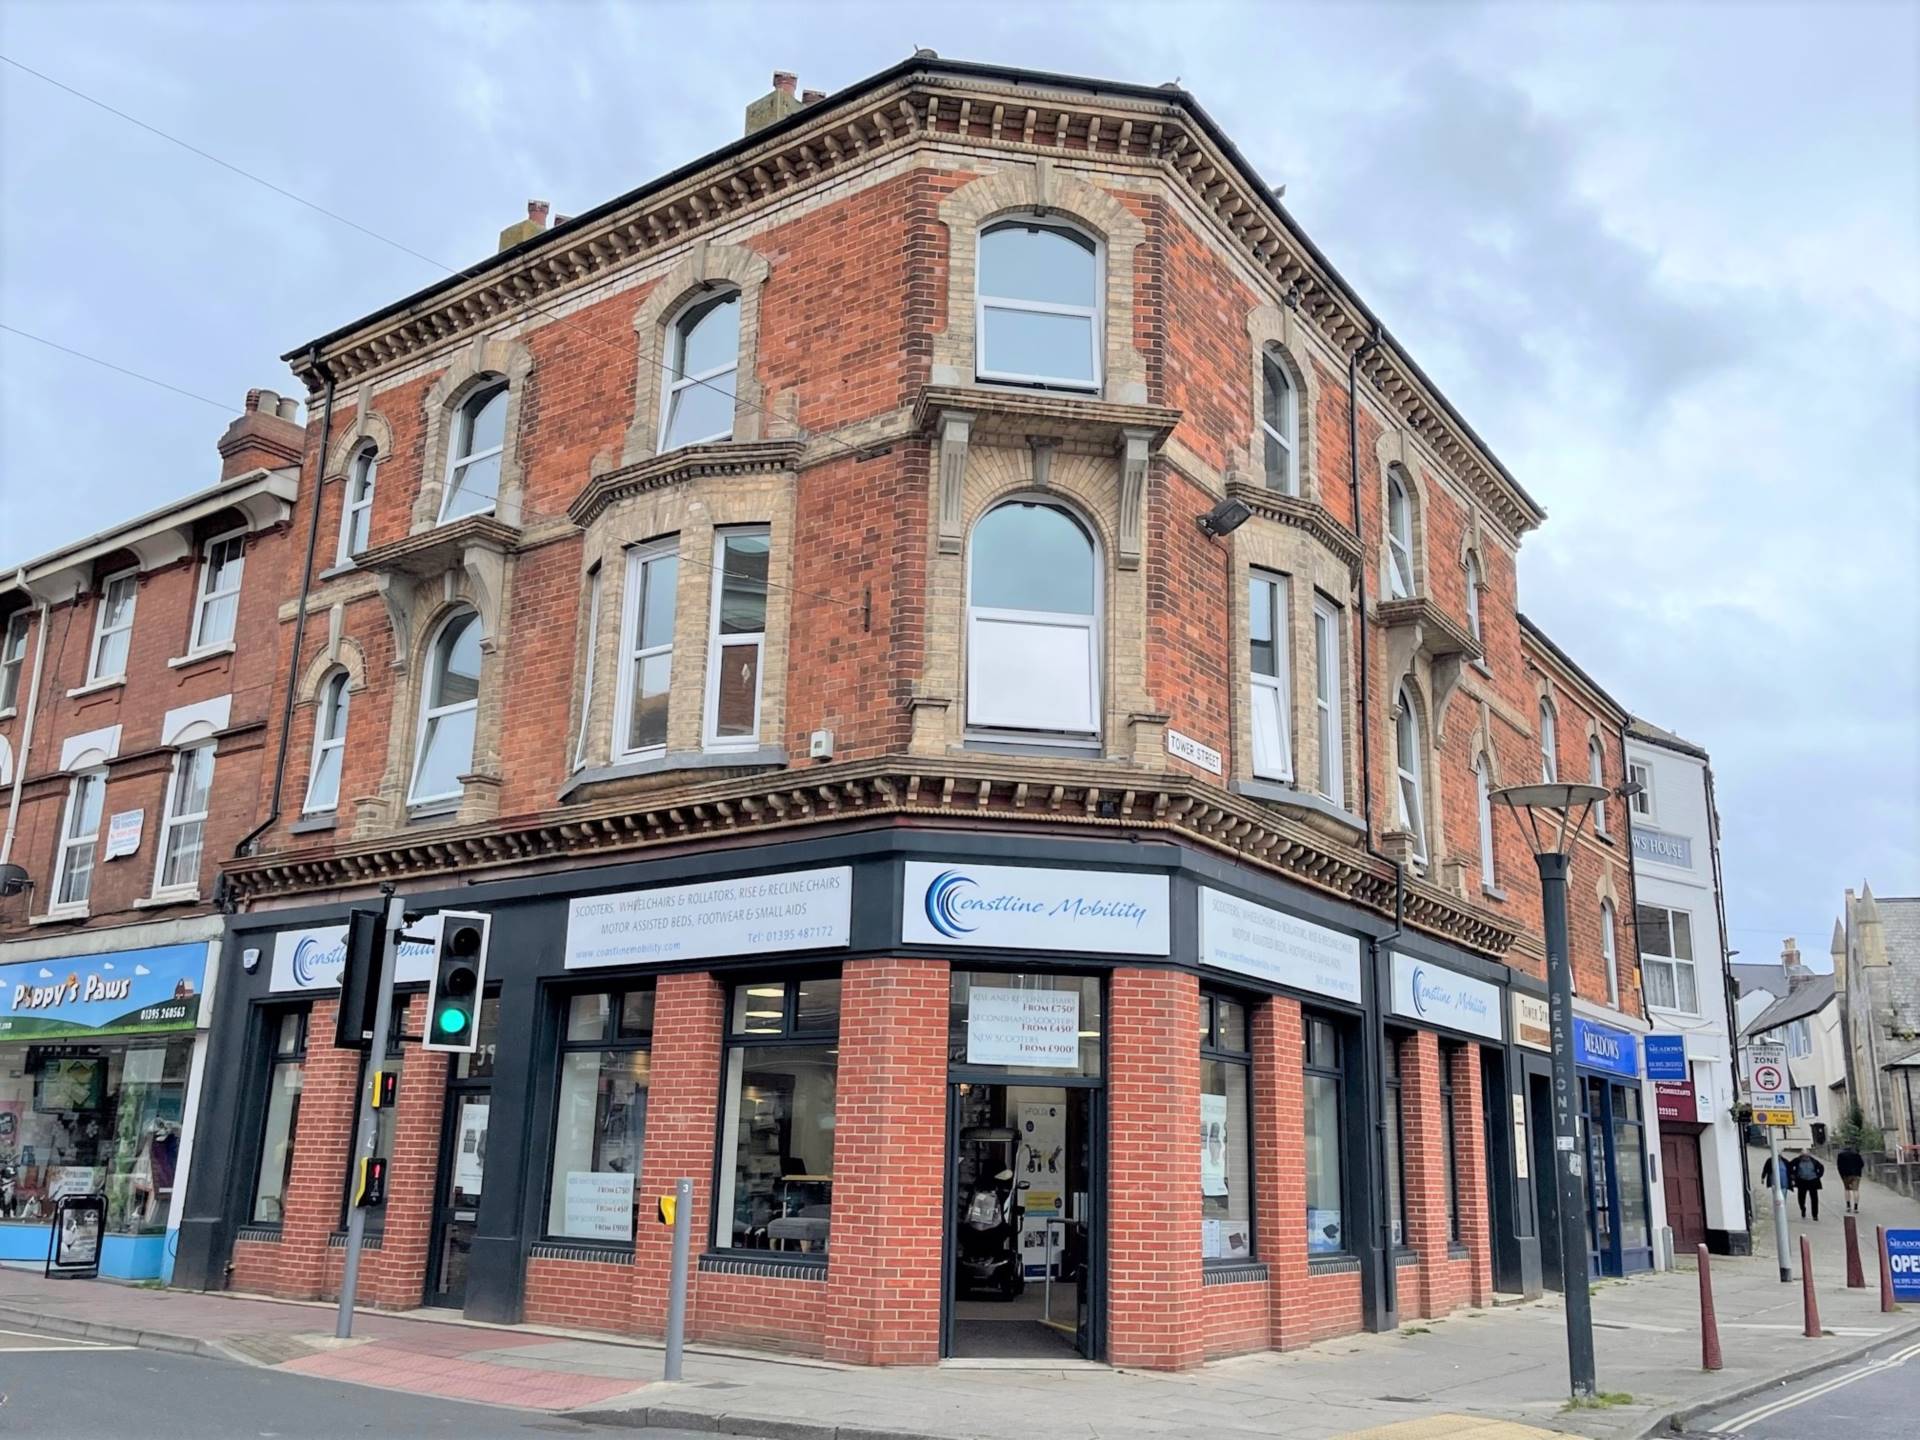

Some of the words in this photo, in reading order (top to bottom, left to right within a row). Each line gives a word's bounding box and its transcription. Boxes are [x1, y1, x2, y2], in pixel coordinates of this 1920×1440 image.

[1171, 735, 1194, 756] TOWER
[1196, 748, 1219, 769] STREET
[1650, 839, 1683, 859] HOUSE
[620, 894, 675, 913] WHEELCHAIRS
[678, 896, 685, 906] &
[740, 887, 757, 898] RISE
[760, 885, 767, 897] &
[768, 881, 804, 896] RECLINE
[806, 876, 840, 891] CHAIRS
[601, 923, 629, 935] MOTOR
[633, 917, 669, 932] ASSISTED
[671, 915, 695, 927] BEDS,
[698, 910, 744, 926] FOOTWEAR
[746, 908, 753, 920] &
[755, 906, 783, 919] SMALL
[785, 903, 807, 916] AIDS
[1049, 896, 1148, 928] Mobility
[766, 929, 795, 942] 01395
[84, 974, 132, 1001] Paws
[1023, 1003, 1049, 1012] FROM
[1022, 1023, 1048, 1032] FROM
[1020, 1043, 1046, 1052] FROM
[1584, 1031, 1619, 1060] MEADOWS
[1754, 1056, 1780, 1064] ZONE
[367, 1081, 373, 1089] 2
[682, 1184, 689, 1193] 3
[1889, 1240, 1920, 1248] MEADO
[1891, 1255, 1920, 1273] OPE
